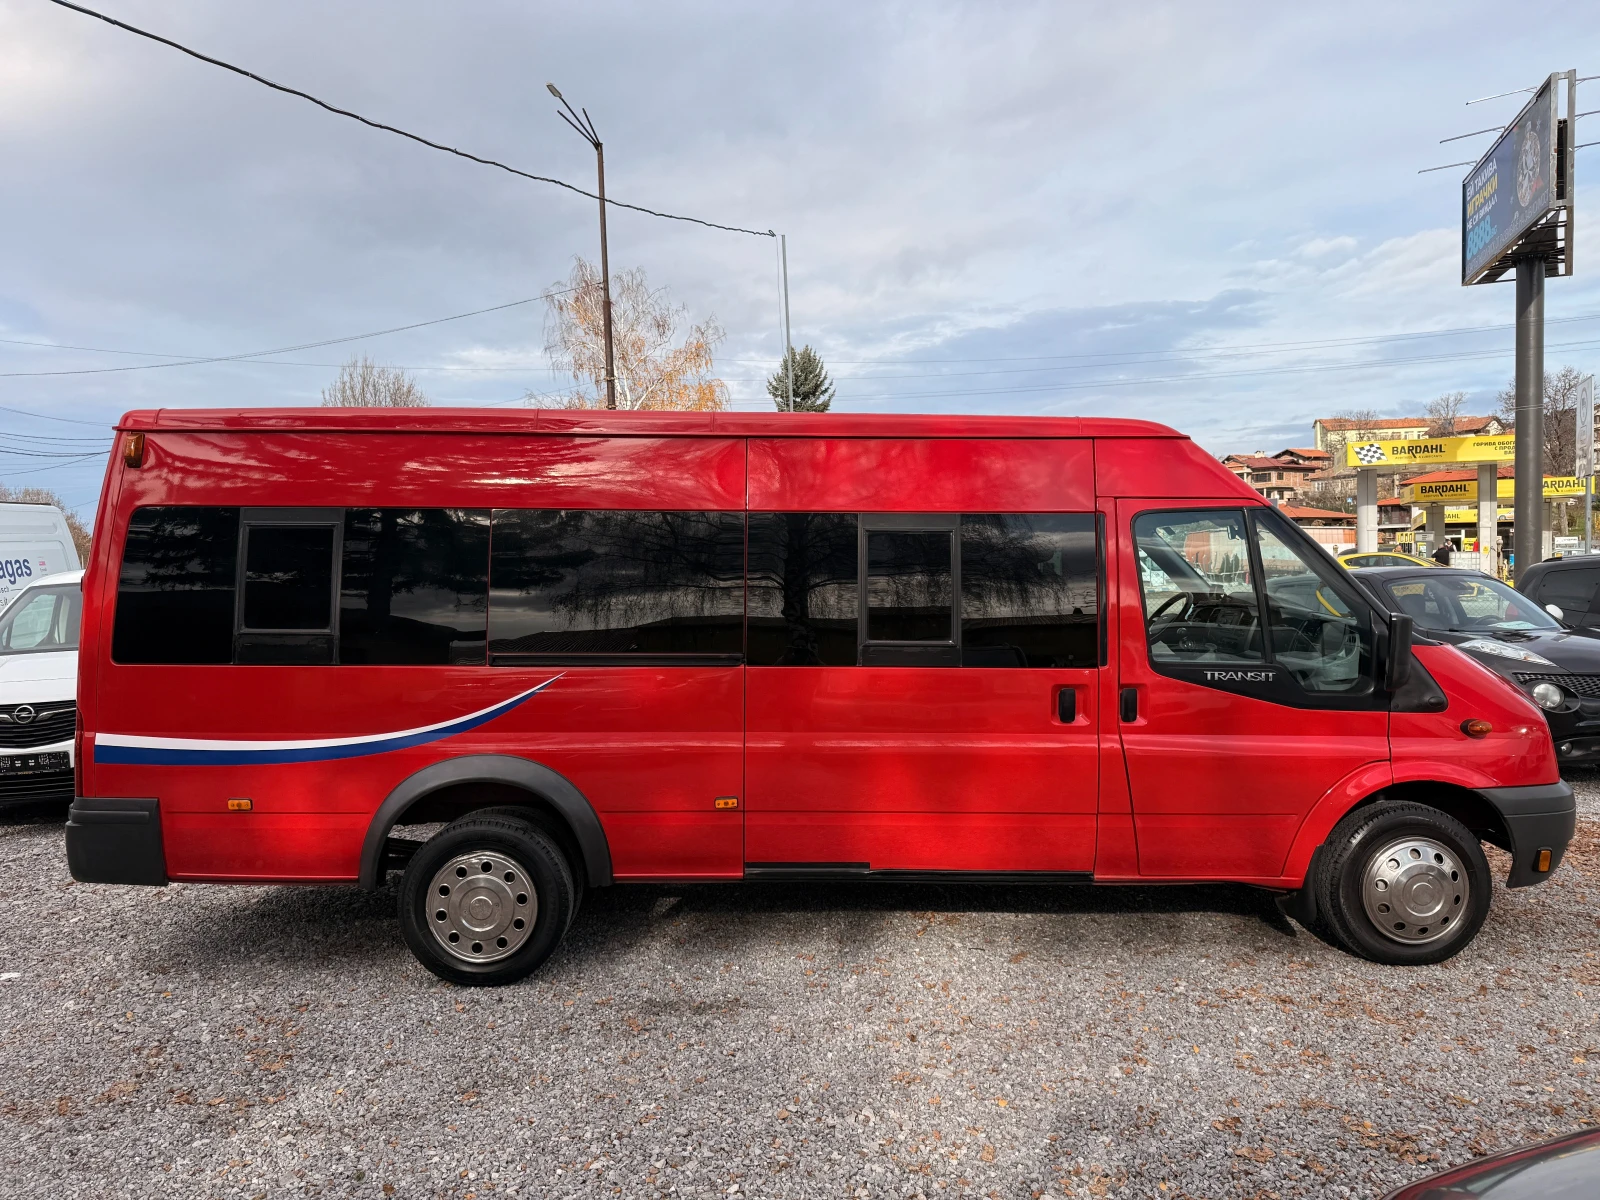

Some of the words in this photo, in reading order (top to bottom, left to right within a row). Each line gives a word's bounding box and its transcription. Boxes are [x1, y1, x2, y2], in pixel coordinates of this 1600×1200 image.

[1466, 182, 1474, 202] ЕЙ
[1474, 158, 1497, 192] ТАКИВА
[1467, 173, 1498, 218] ИГРАЧКИ
[1466, 220, 1472, 232] НЕ
[1472, 215, 1479, 226] СИ
[1391, 444, 1445, 458] BARDAHL
[1420, 484, 1470, 497] BARDAHL
[1543, 480, 1586, 492] ARDAHL
[1203, 670, 1277, 681] TRANSIT
